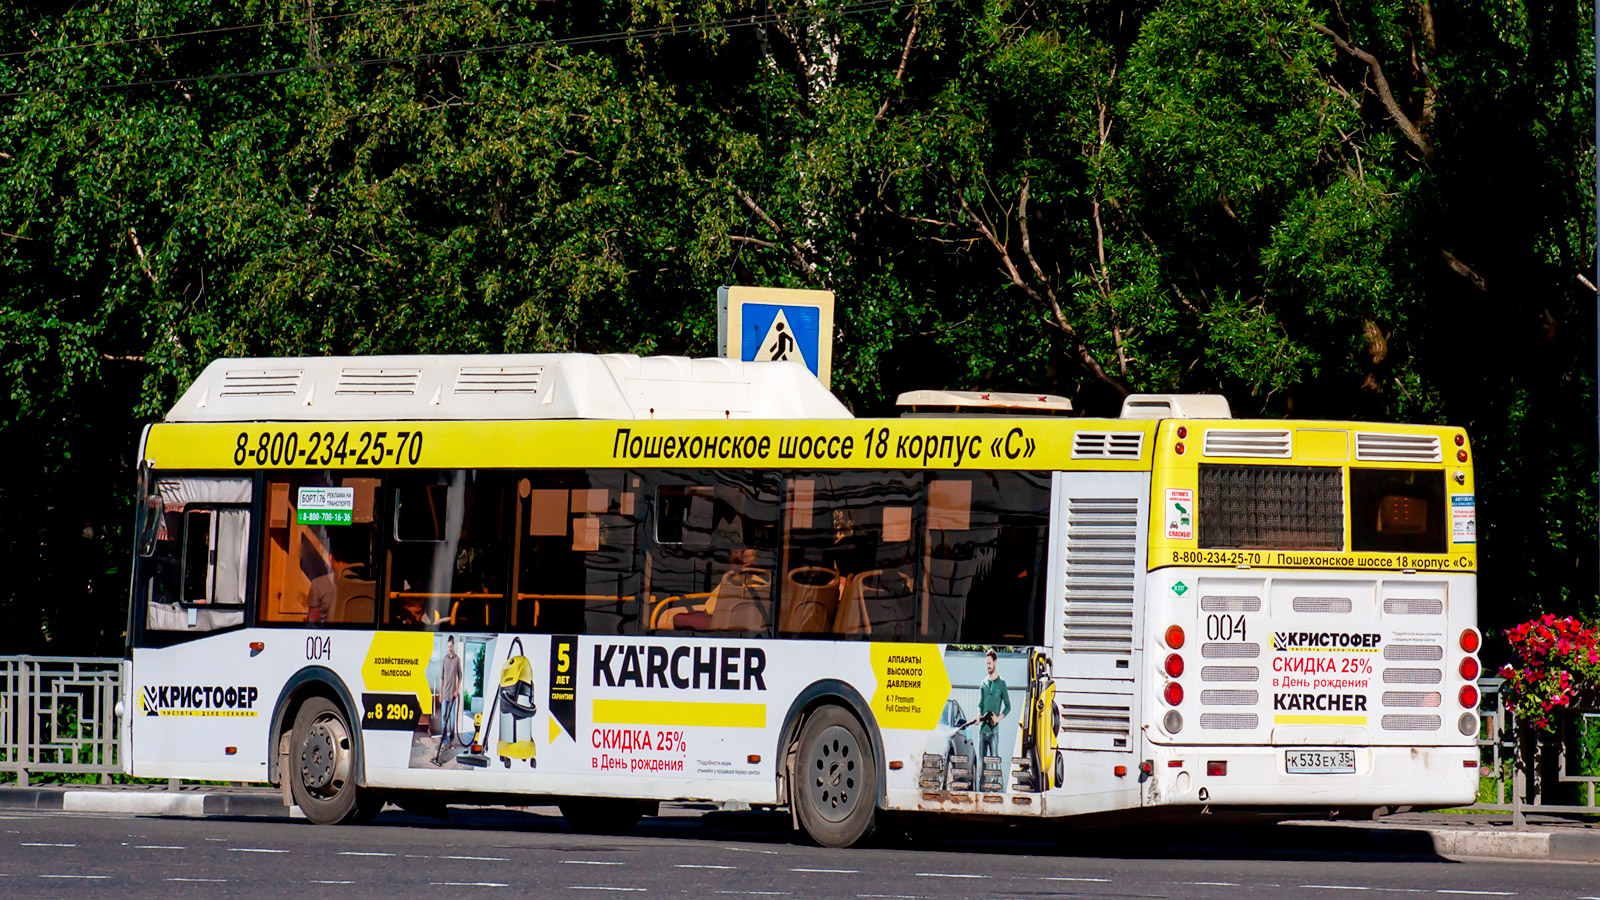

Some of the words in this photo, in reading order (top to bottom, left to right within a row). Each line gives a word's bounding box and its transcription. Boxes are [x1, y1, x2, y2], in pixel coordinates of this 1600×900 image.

[233, 431, 423, 466] 8-800-234-25-70
[613, 428, 770, 459] Пошехонское
[778, 434, 854, 459] шоссе
[863, 428, 888, 459] 18
[896, 434, 981, 467] корпус
[990, 427, 1036, 459] «С»
[303, 512, 351, 522] 8-800-700-16-36
[1168, 530, 1191, 538] СПАСИБО!
[1172, 551, 1261, 564] 8-800-234-25-70
[1277, 553, 1354, 566] Пошехонское
[1357, 557, 1392, 567] шоссе
[1396, 556, 1408, 567] 18
[1411, 557, 1450, 569] корпус
[1453, 556, 1473, 567] «С»
[1206, 614, 1247, 642] 004
[1287, 632, 1381, 648] КРИСТОФЕР
[306, 636, 331, 661] 004
[374, 656, 419, 665] ХОЗЯЙСТВЕННЫЕ
[556, 643, 570, 673] 5
[888, 656, 922, 664] АППАРАТЫ
[1272, 657, 1336, 675] СКИДКА
[1341, 658, 1372, 674] 25%
[381, 669, 412, 677] ПЫЛЕСОСЫ
[592, 644, 767, 690] KÄRCHER
[887, 667, 923, 676] ВЫСОКОГО
[556, 676, 570, 685] ЛЕТ
[886, 680, 921, 688] ДАВЛЕНИЯ
[1272, 678, 1279, 687] в
[1282, 676, 1310, 688] День
[158, 685, 258, 708] КРИСТОФЕР
[551, 692, 574, 700] ГАРАНТИИ
[895, 695, 914, 703] Premium
[1273, 693, 1367, 711] KÄRCHER
[895, 704, 911, 713] Control
[911, 705, 921, 713] Plus
[591, 729, 652, 753] СКИДКА
[656, 731, 686, 752] 25%
[592, 757, 598, 768] в
[600, 754, 628, 771] День
